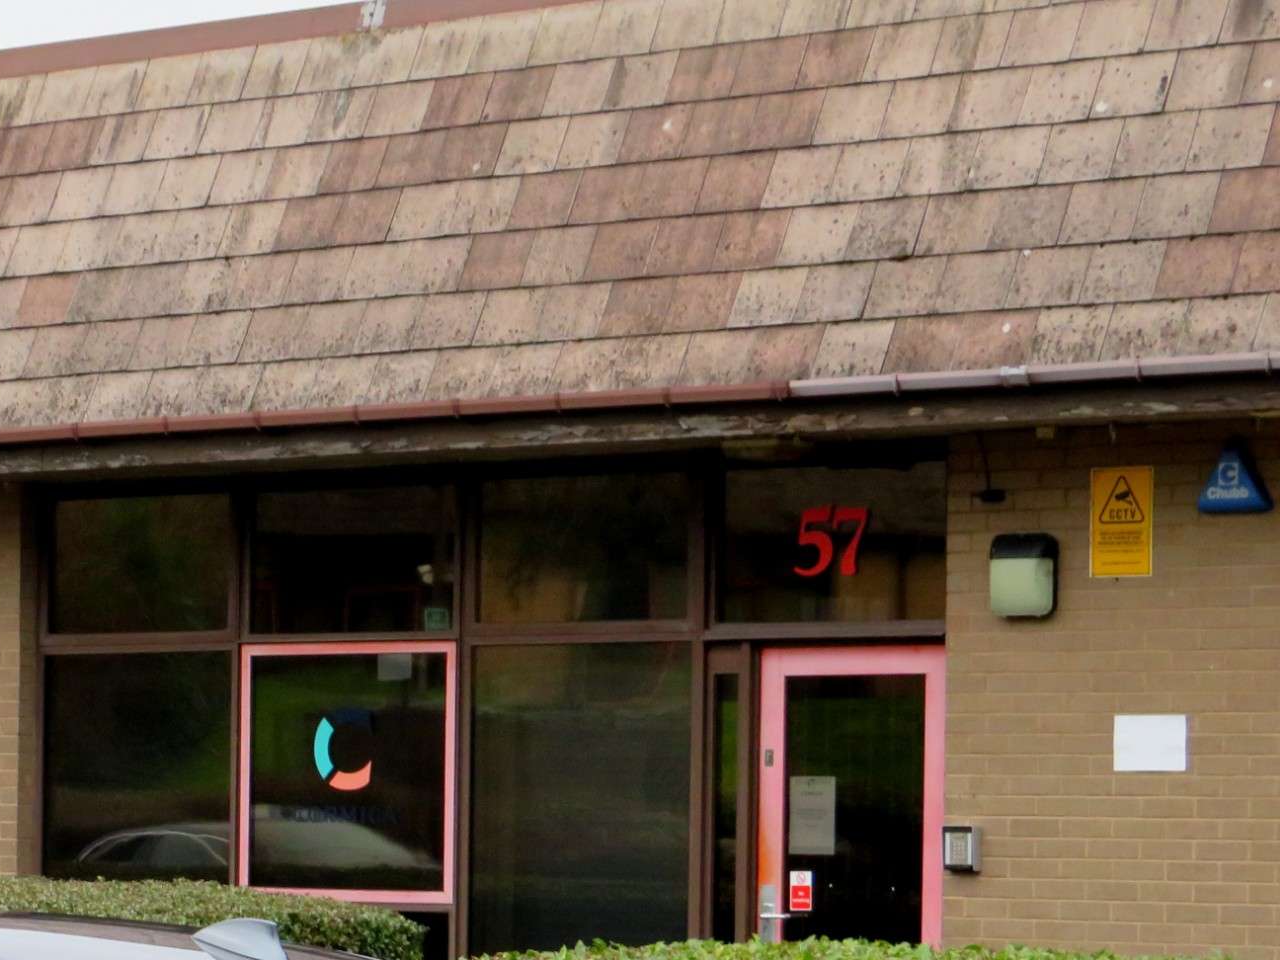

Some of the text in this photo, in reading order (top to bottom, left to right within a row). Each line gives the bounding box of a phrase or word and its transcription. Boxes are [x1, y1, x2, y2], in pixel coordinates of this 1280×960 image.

[1207, 486, 1249, 500] Chubb
[1109, 507, 1136, 520] CCTV
[793, 505, 868, 577] 57
